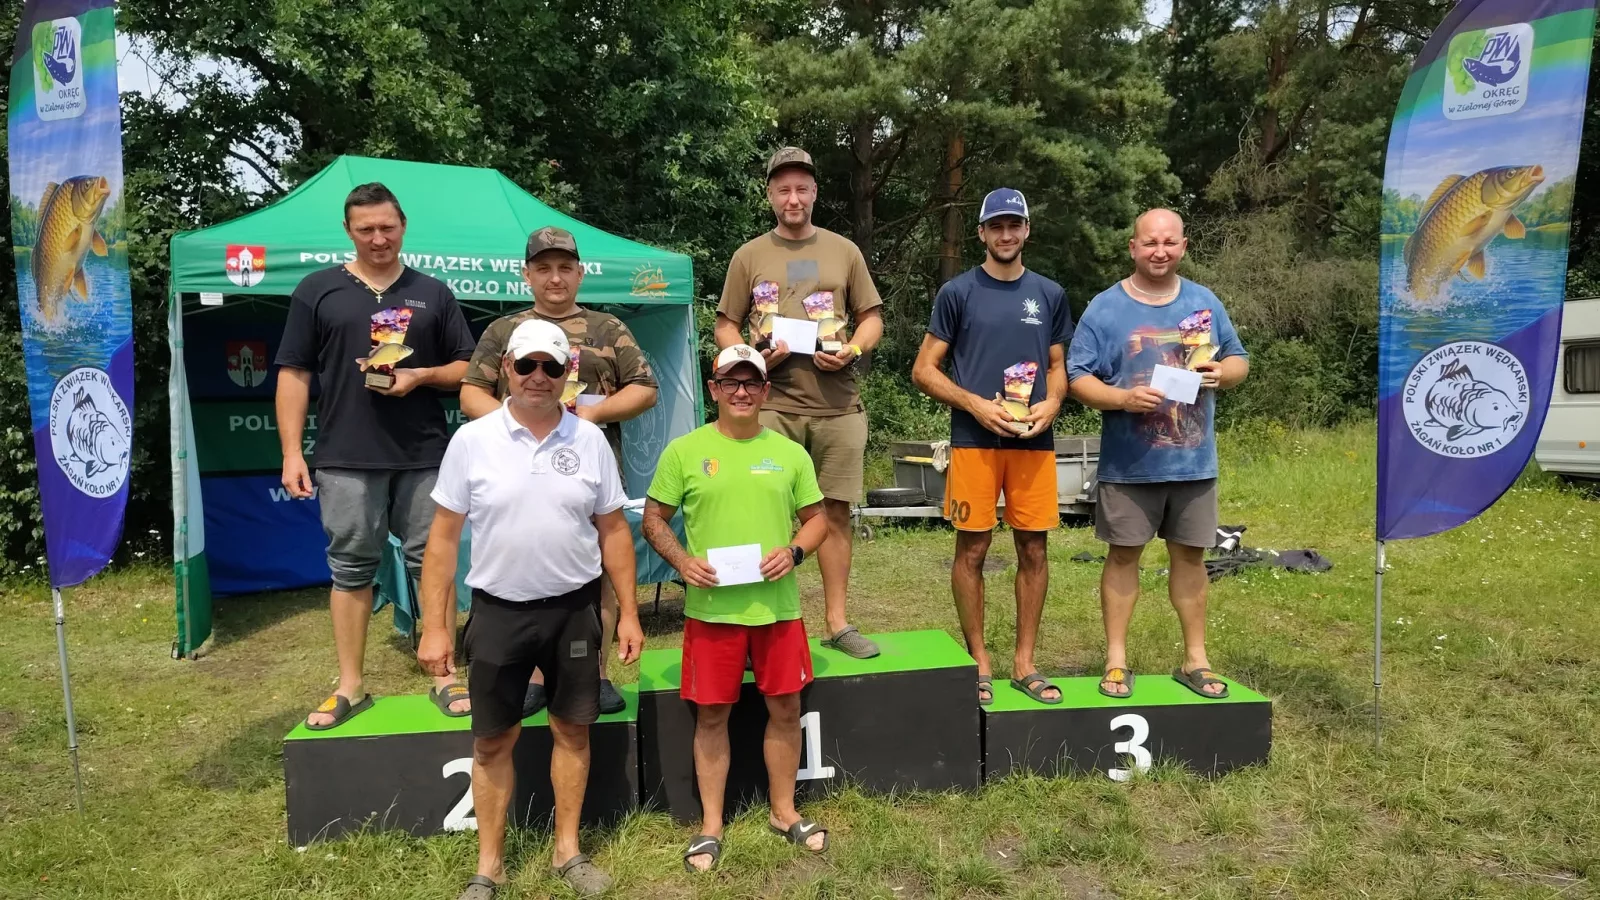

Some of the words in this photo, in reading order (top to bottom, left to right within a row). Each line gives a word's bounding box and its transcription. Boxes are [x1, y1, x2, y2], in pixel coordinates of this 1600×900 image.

[1480, 31, 1519, 64] PZW
[58, 87, 80, 99] OKRĘG
[1456, 101, 1492, 112] Zielonej
[1493, 98, 1520, 108] Górze
[1482, 86, 1520, 99] OKRĘG
[300, 252, 357, 264] POLS
[398, 252, 484, 273] WIĄZEK
[447, 279, 500, 294] KOŁO
[506, 281, 532, 296] NR
[1406, 363, 1429, 403] POLSKI
[1426, 344, 1482, 366] ZWIĄZEK
[1485, 347, 1528, 403] WĘDKARSKI
[51, 392, 62, 436] POLSKI
[60, 371, 98, 394] ZWIĄZEK
[229, 415, 318, 431] POLI
[1410, 420, 1442, 450] ŻAGAŃ
[1442, 443, 1476, 455] KOŁO
[1477, 441, 1495, 454] NR
[1495, 437, 1502, 446] 1
[57, 454, 84, 488] ŻAGAŃ
[84, 482, 106, 495] KOŁO
[106, 480, 117, 492] NR
[950, 498, 971, 523] 20
[797, 711, 836, 781] 1
[1108, 713, 1152, 782] 3
[442, 757, 479, 831] 2
